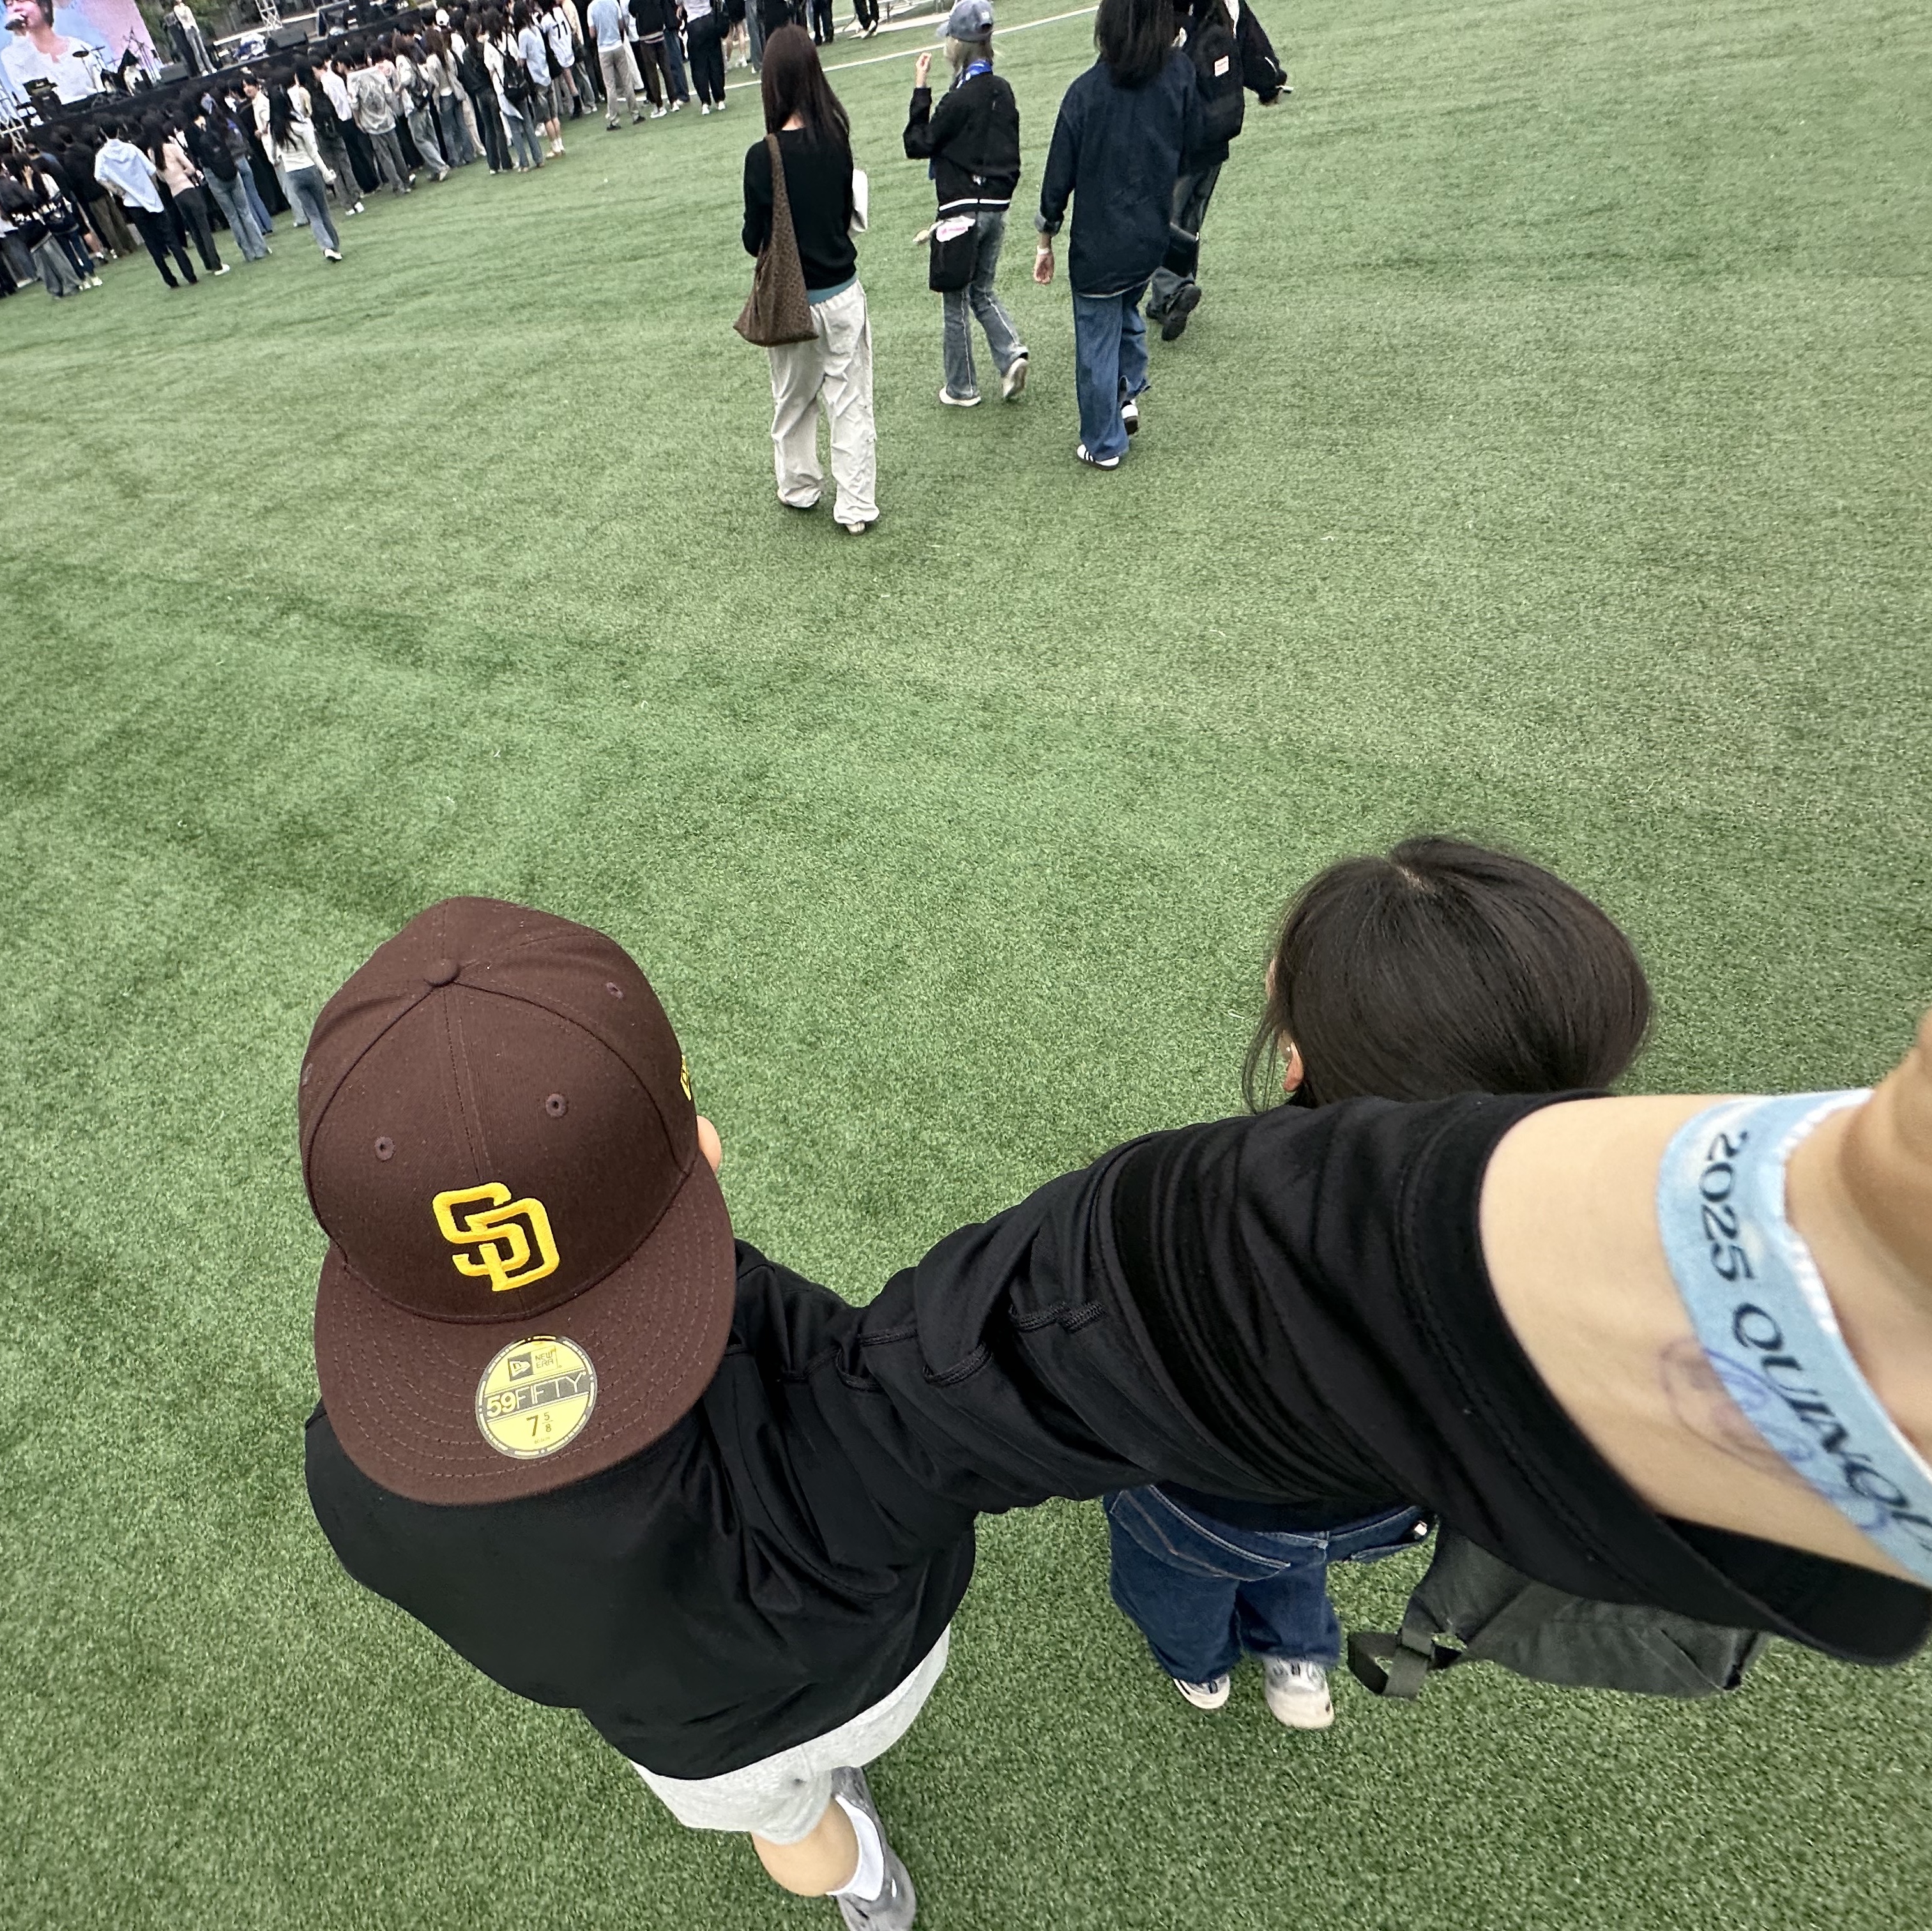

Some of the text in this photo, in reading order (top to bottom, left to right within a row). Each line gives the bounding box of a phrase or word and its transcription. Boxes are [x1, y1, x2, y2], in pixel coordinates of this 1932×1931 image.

[1698, 1130, 1755, 1281] 2025
[432, 1182, 560, 1292] SD
[535, 1350, 553, 1361] NEW
[536, 1358, 554, 1368] ERA
[487, 1372, 586, 1418] 59FIFTY
[526, 1415, 538, 1437] 7
